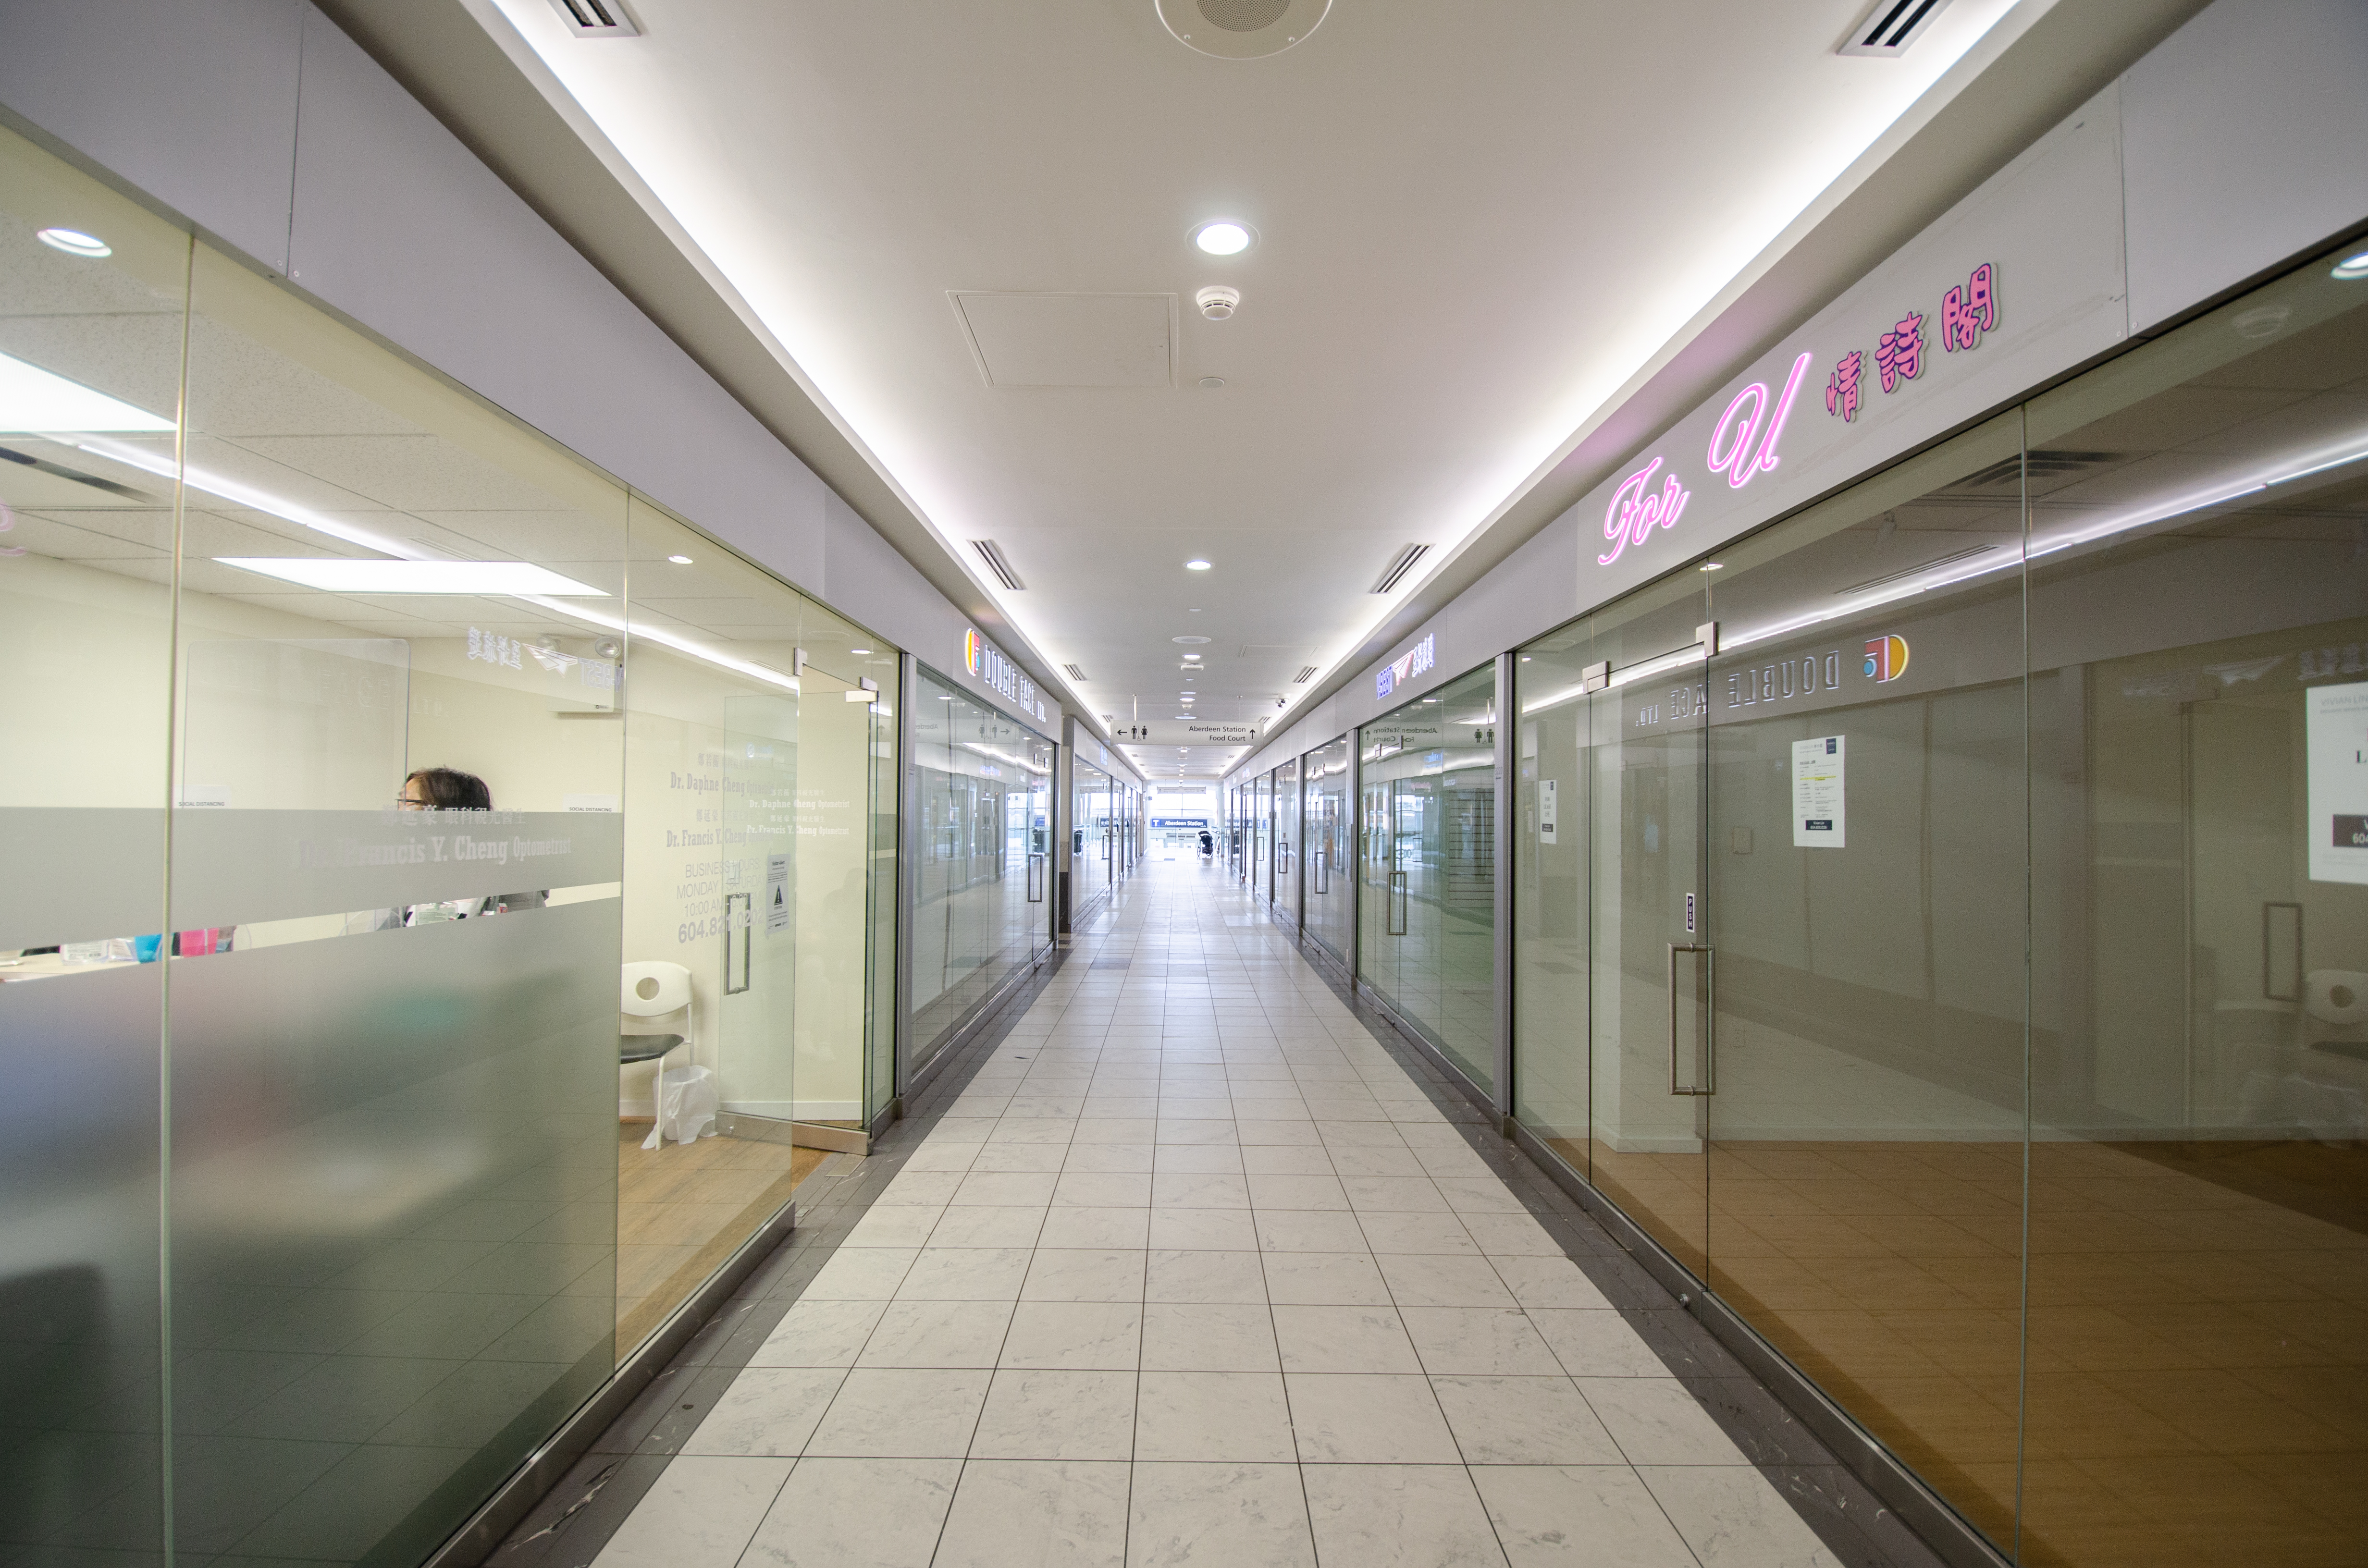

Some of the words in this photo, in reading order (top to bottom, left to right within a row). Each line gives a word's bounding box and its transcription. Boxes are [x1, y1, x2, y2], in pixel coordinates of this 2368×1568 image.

[1597, 456, 1691, 565] For
[1707, 352, 1813, 489] U
[985, 644, 1016, 702] DOUBLE
[1020, 676, 1035, 715] FACE
[670, 772, 684, 789] Dr.
[687, 772, 719, 795] Daphne
[722, 776, 745, 797] Cheng
[750, 799, 760, 808] Dr.
[763, 799, 791, 810] Daphne
[794, 799, 816, 810] Cheng
[818, 799, 850, 809] Optometrist
[667, 830, 679, 847] Dr.
[682, 829, 713, 846] Francis
[715, 828, 722, 845] Y.
[724, 828, 746, 847] Cheng
[759, 824, 786, 834] Francis
[788, 825, 794, 834] Y.
[819, 826, 850, 836] Optometrist
[431, 836, 448, 862] Y.
[455, 835, 508, 866] Cheng
[513, 835, 572, 861] Optometrist
[685, 860, 730, 879] BUSINESS
[677, 880, 719, 900] MONDAY
[684, 900, 709, 918] 10:00
[711, 897, 724, 912] AM
